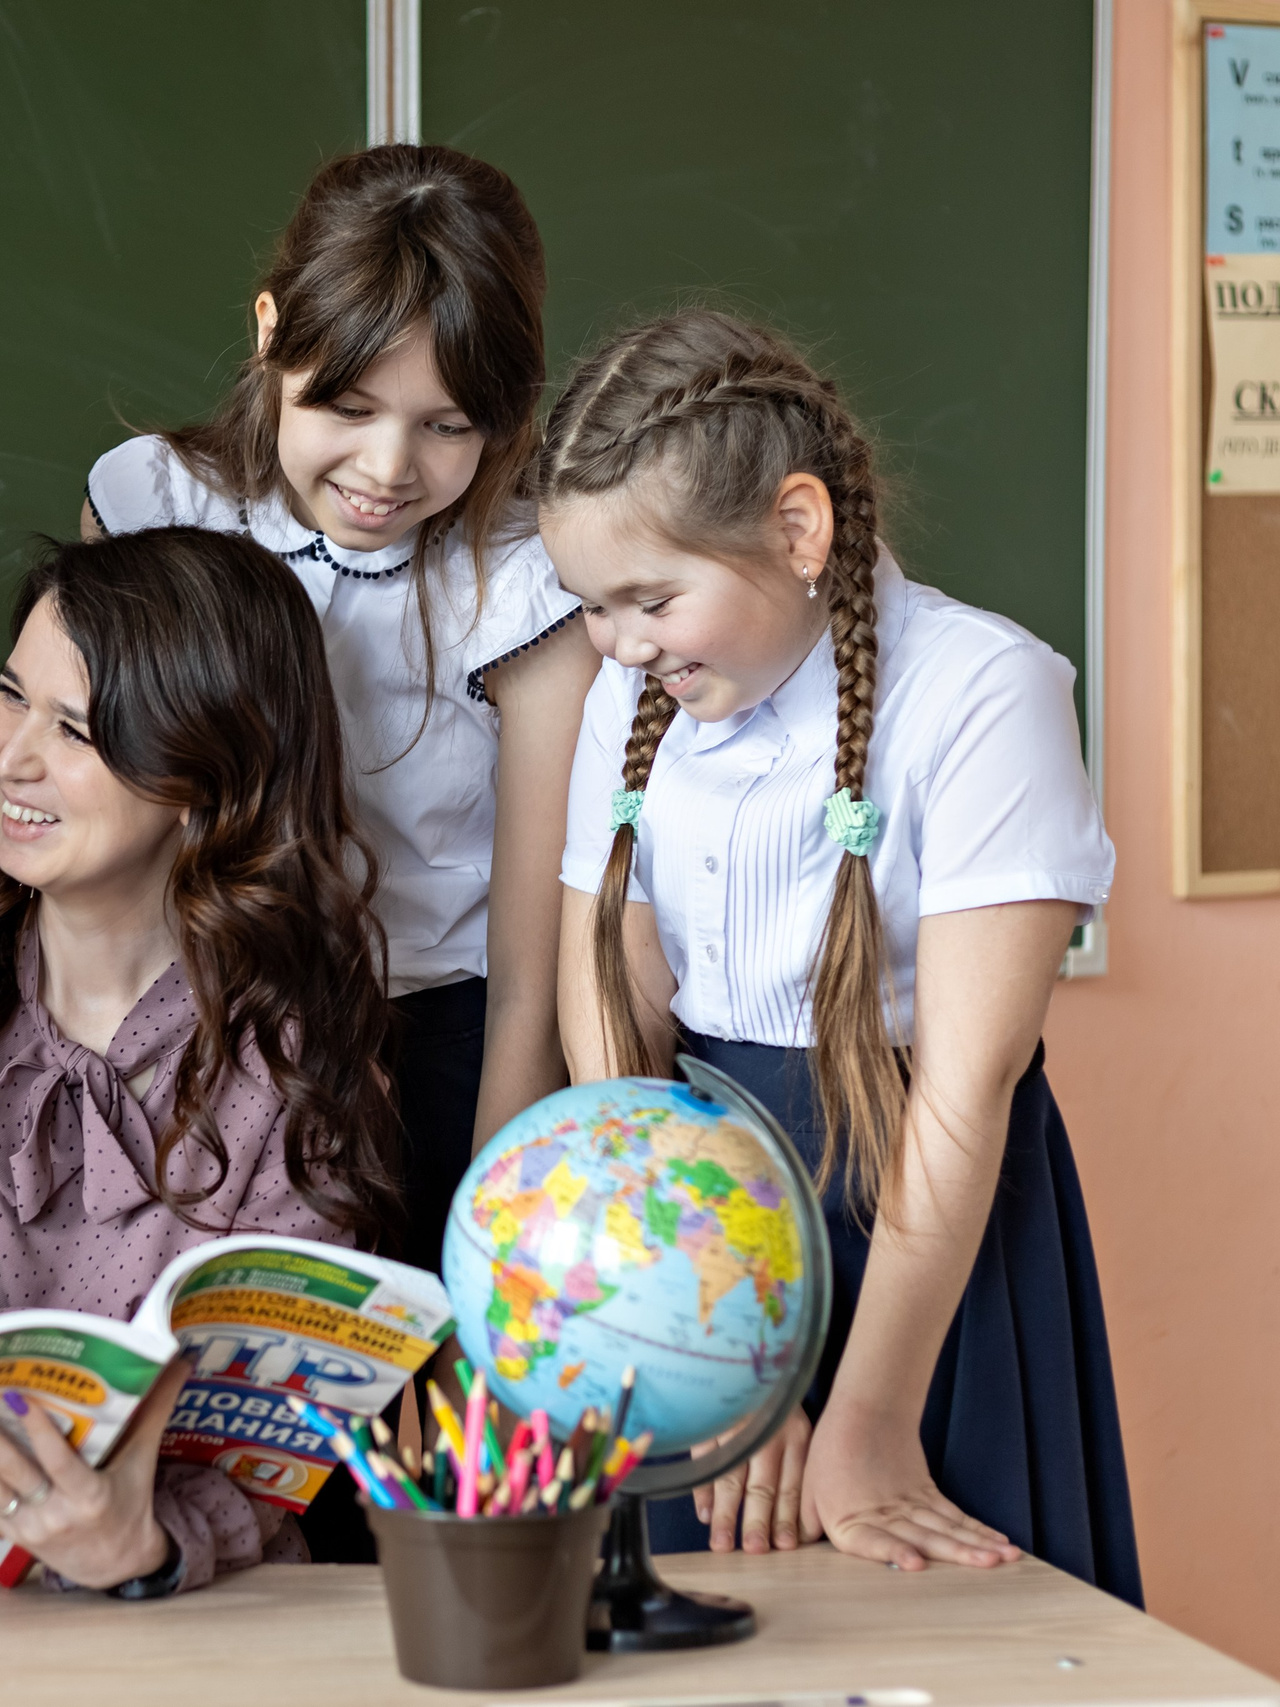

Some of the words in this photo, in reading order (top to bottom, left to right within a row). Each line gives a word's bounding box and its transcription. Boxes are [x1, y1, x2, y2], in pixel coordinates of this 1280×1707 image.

[1228, 57, 1250, 88] V
[1225, 203, 1244, 236] S
[349, 1328, 403, 1354] МИР
[177, 1389, 340, 1428] ПОВЫ
[167, 1408, 325, 1452] ДАНИЯ
